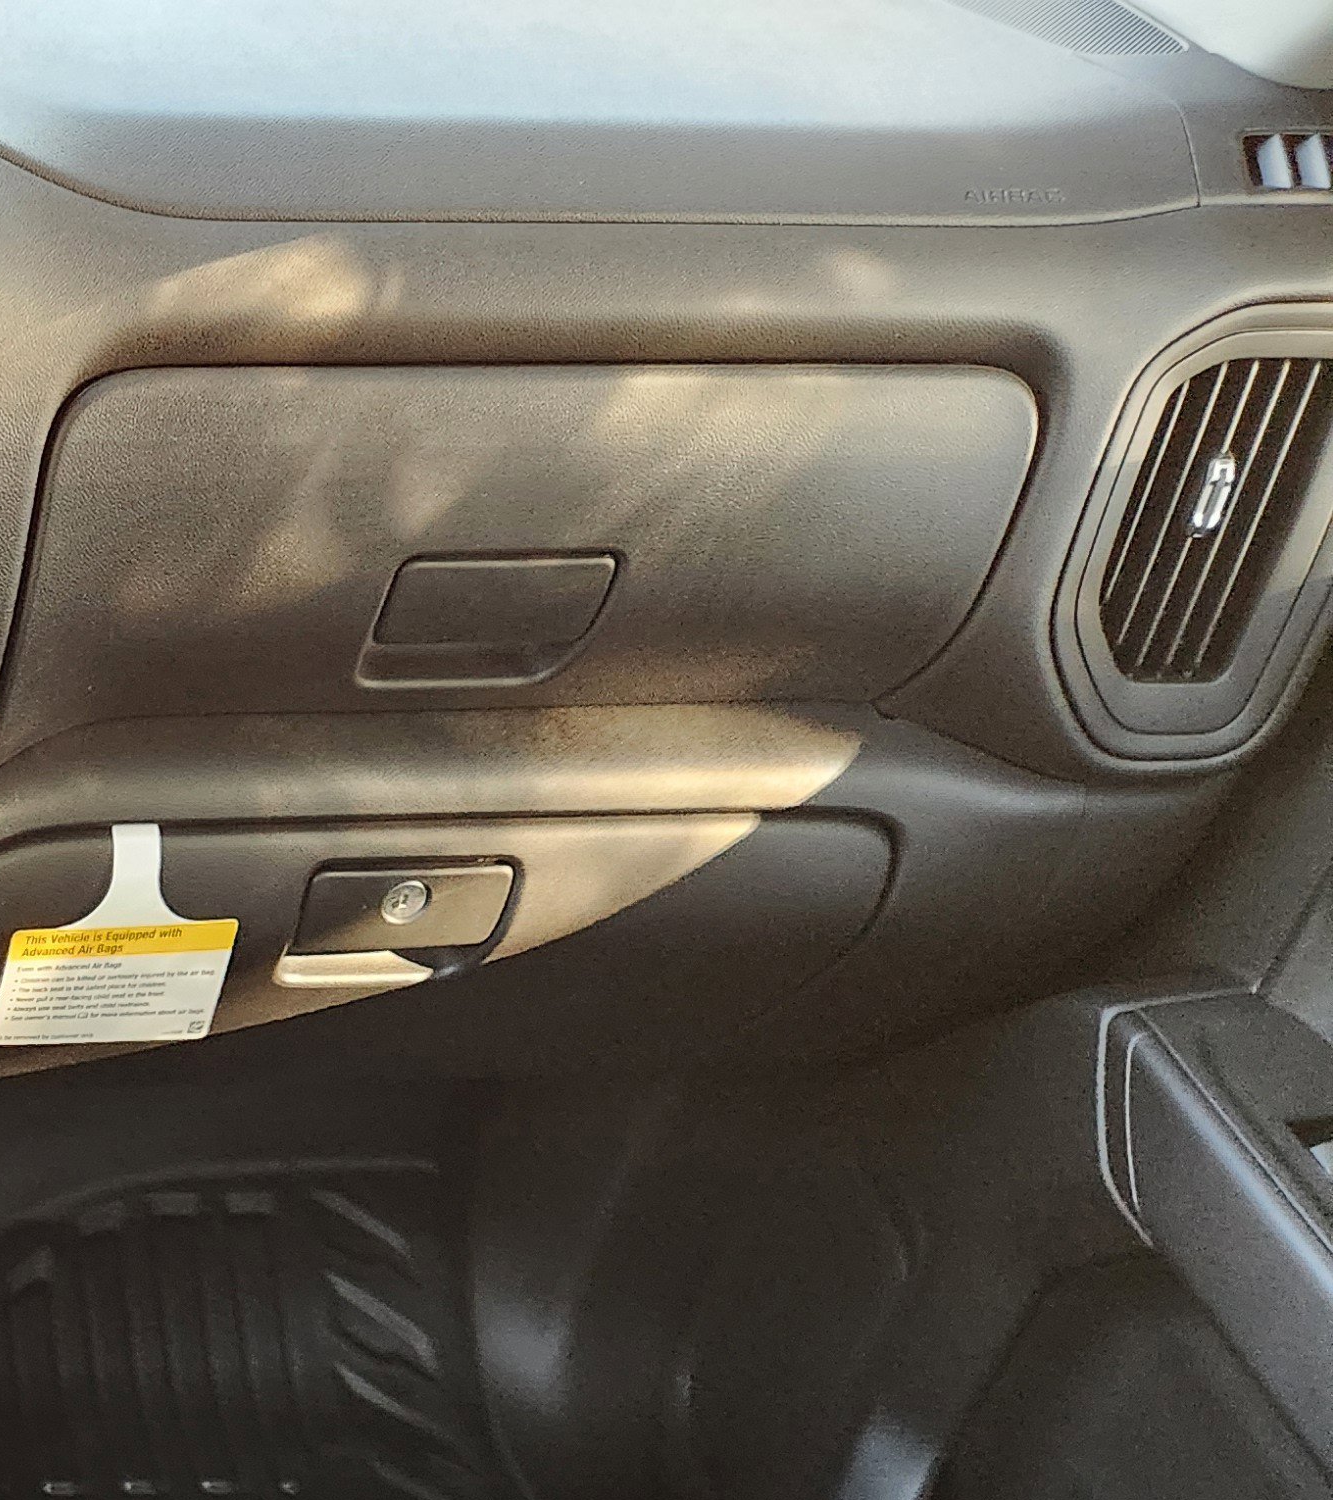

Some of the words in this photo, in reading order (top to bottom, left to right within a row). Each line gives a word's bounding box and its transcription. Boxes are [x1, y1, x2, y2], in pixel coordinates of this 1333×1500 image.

[25, 936, 47, 945] This
[51, 933, 90, 943] Vehicle
[93, 932, 102, 942] is
[106, 928, 157, 942] Equipped
[159, 928, 183, 938] with
[21, 945, 75, 957] Advanced
[77, 945, 93, 955] Air
[97, 944, 123, 955] Bags
